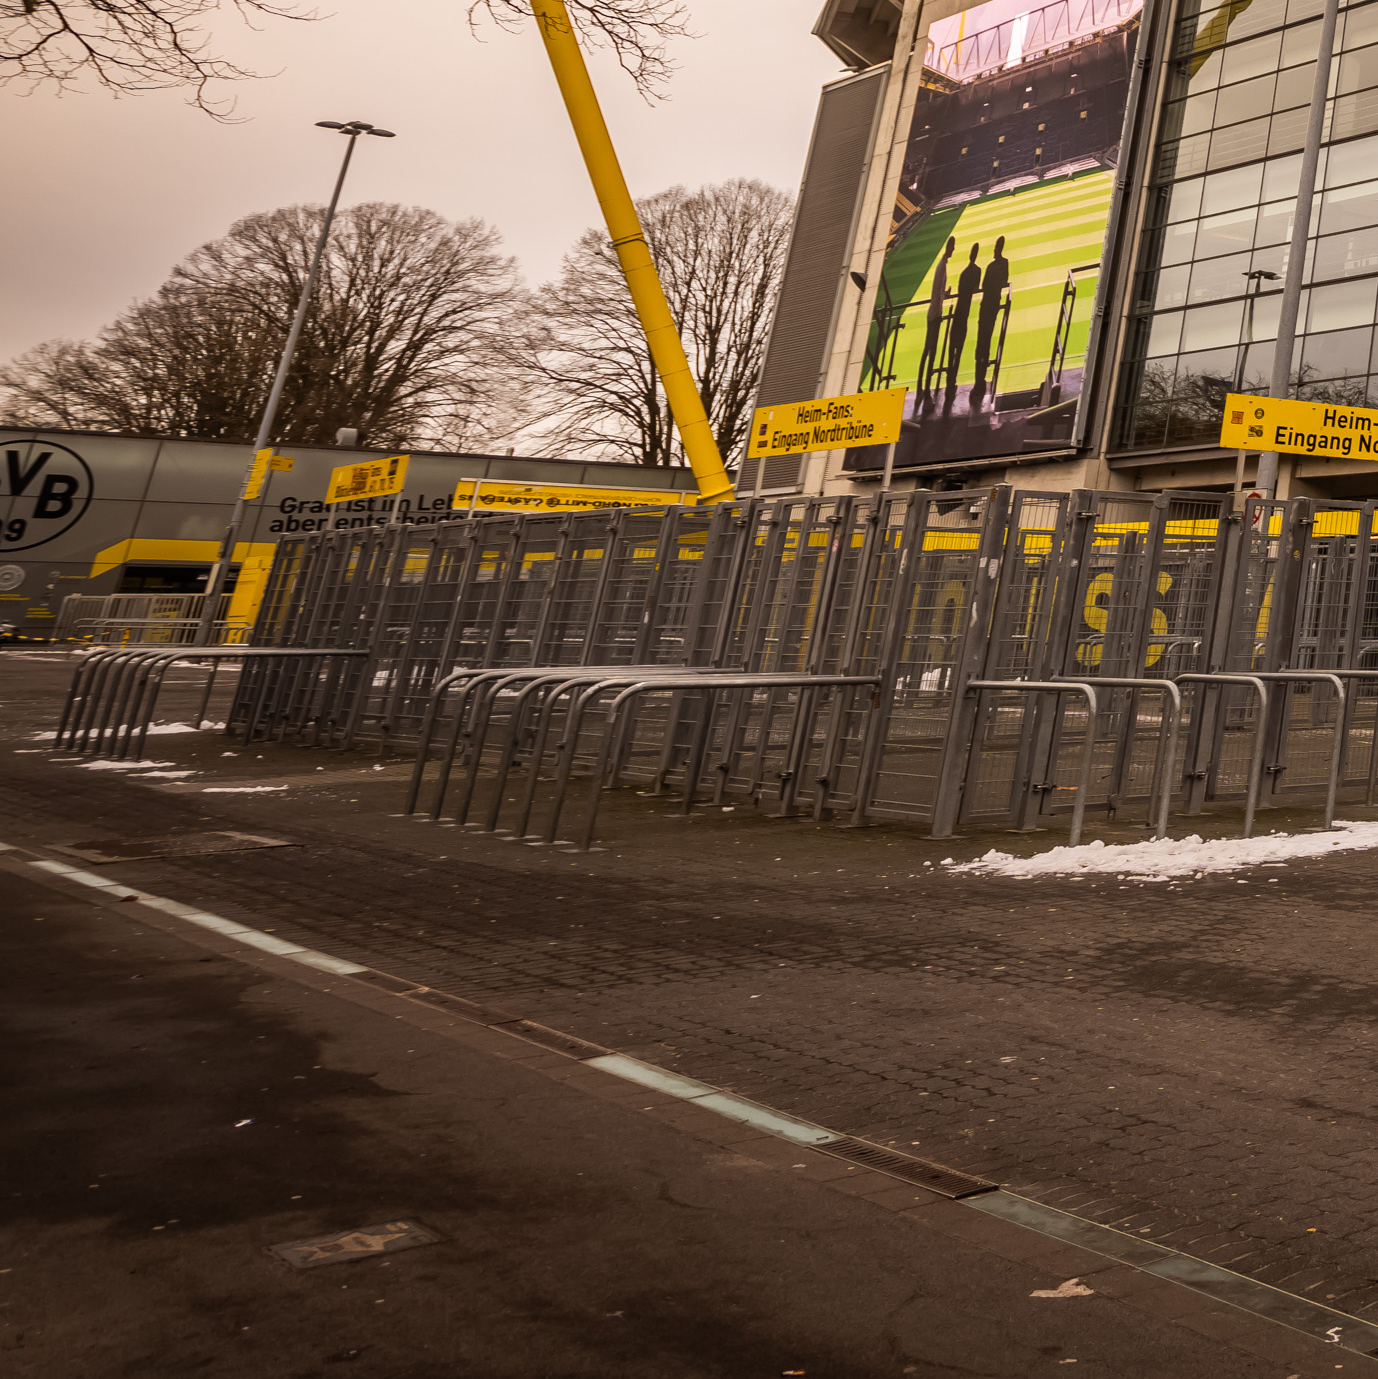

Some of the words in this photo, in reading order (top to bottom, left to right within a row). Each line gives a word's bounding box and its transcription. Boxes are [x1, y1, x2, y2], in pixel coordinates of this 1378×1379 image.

[796, 402, 854, 425] Heim-Fans:
[771, 430, 810, 452] Eingang
[811, 420, 874, 444] Nordtribüne
[1274, 426, 1353, 456] Eingang
[0, 449, 80, 519] VB
[269, 515, 328, 532] aber
